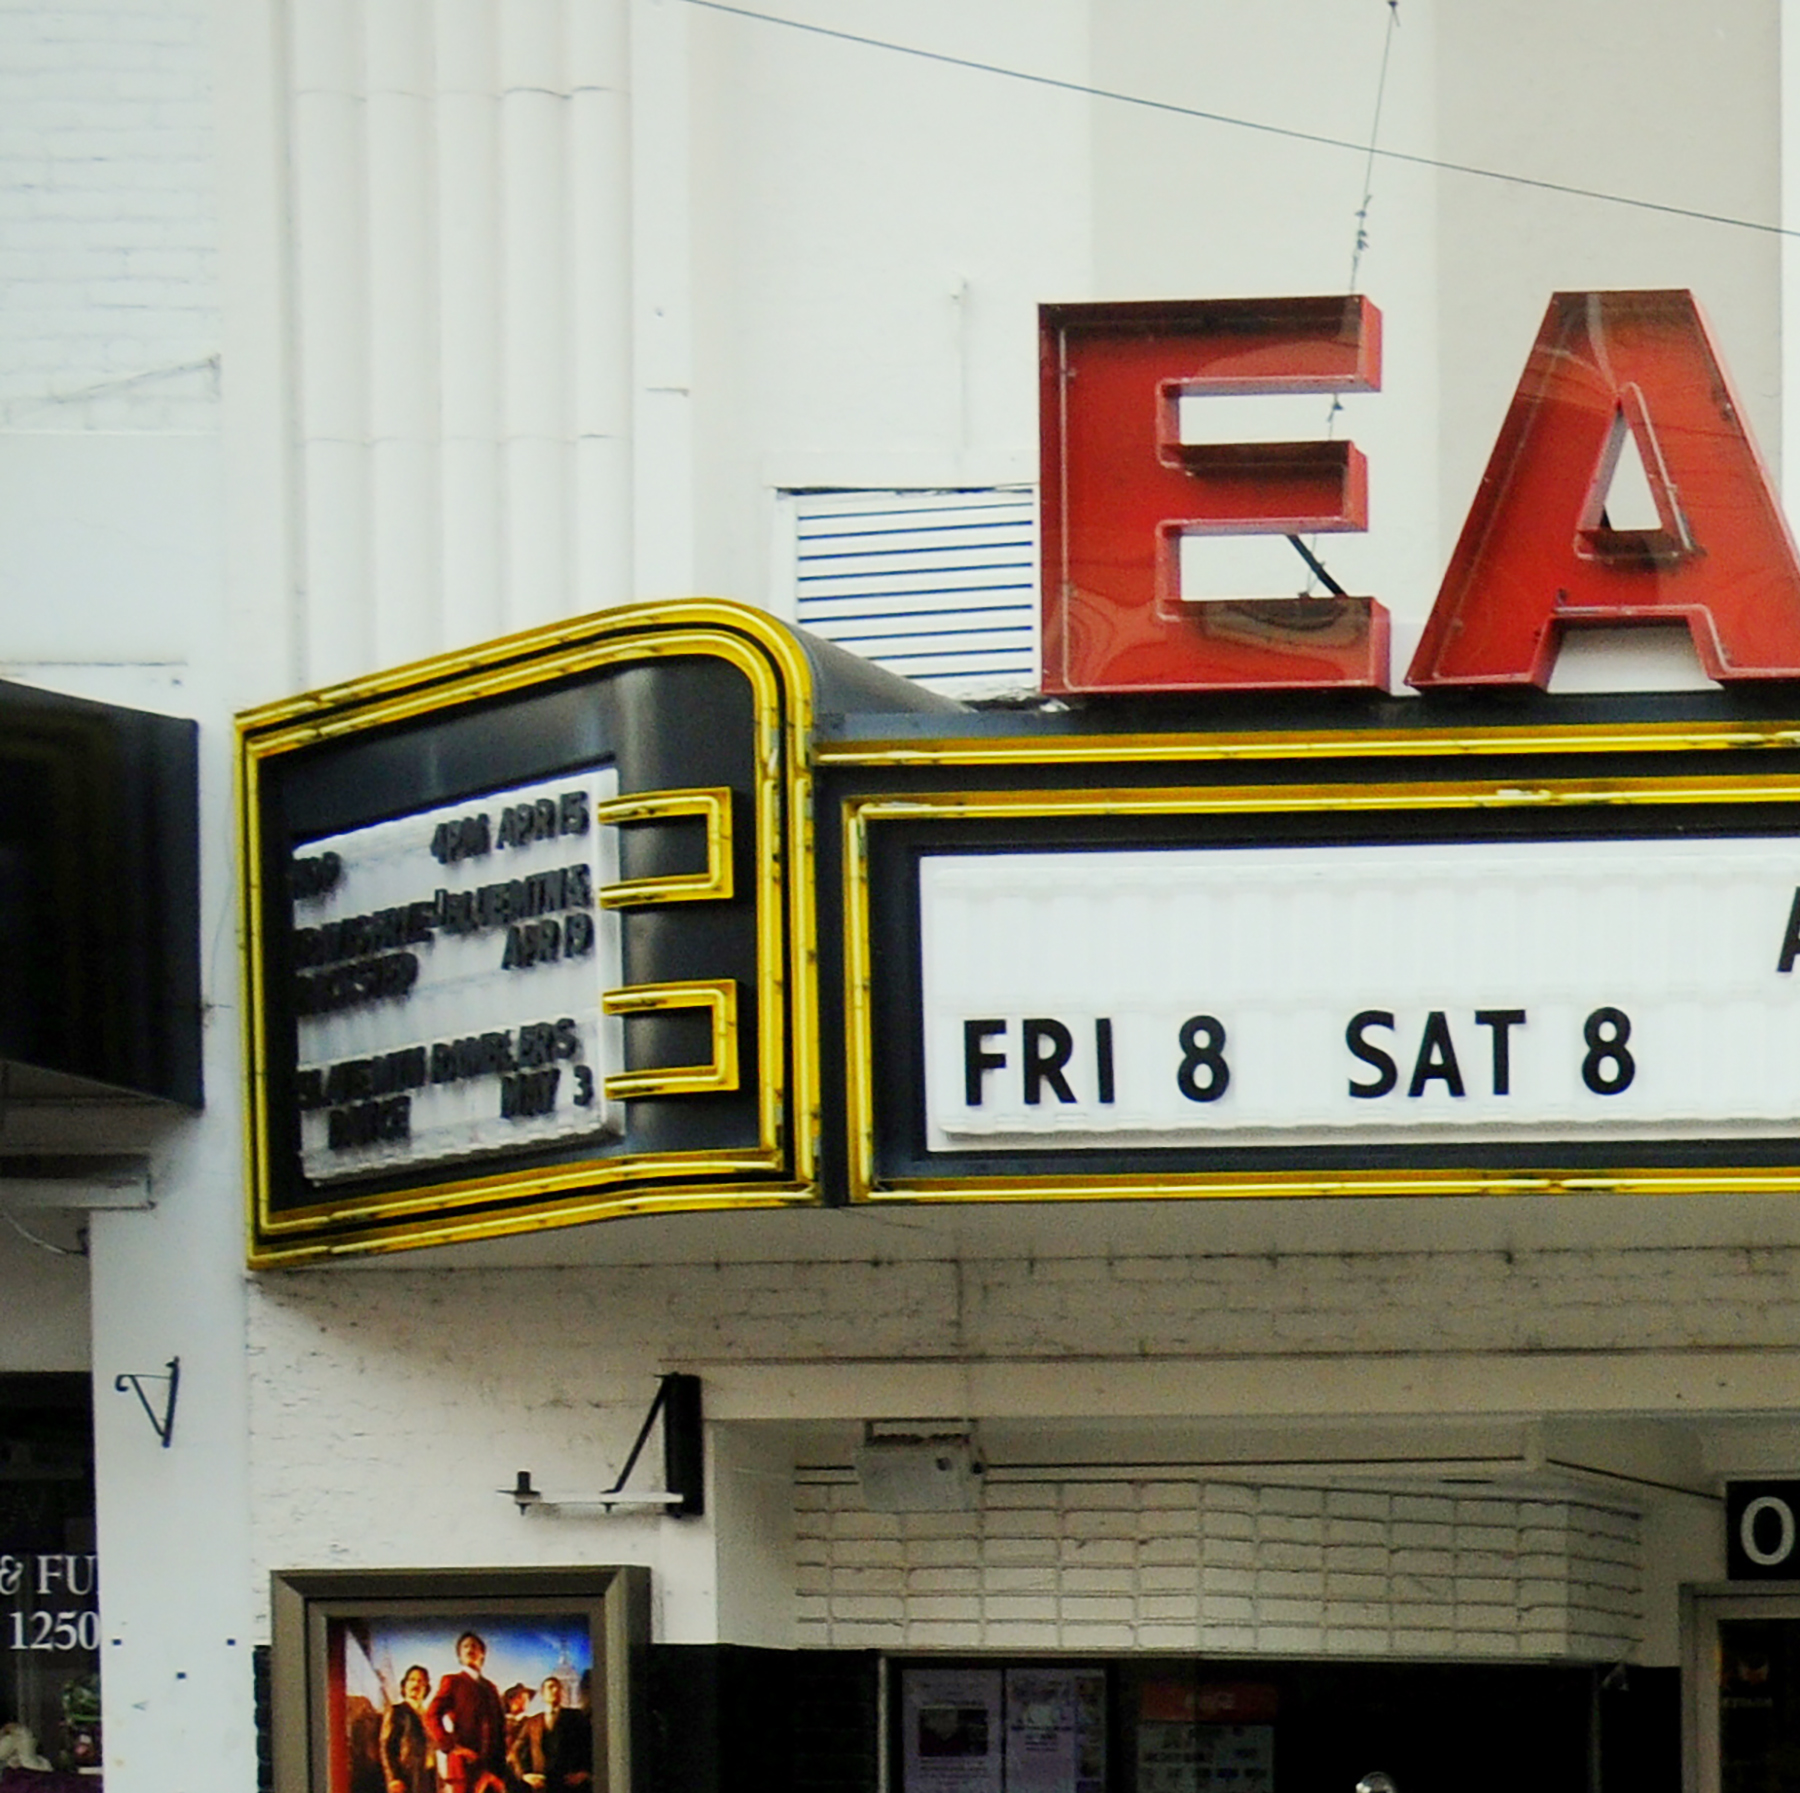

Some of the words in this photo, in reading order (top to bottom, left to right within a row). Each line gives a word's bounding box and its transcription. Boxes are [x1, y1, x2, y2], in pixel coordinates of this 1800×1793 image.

[963, 1017, 1116, 1107] FRI
[1176, 1014, 1231, 1102] 8
[1347, 1008, 1527, 1097] SAT
[1582, 1006, 1636, 1095] 8
[37, 1555, 99, 1595] FU
